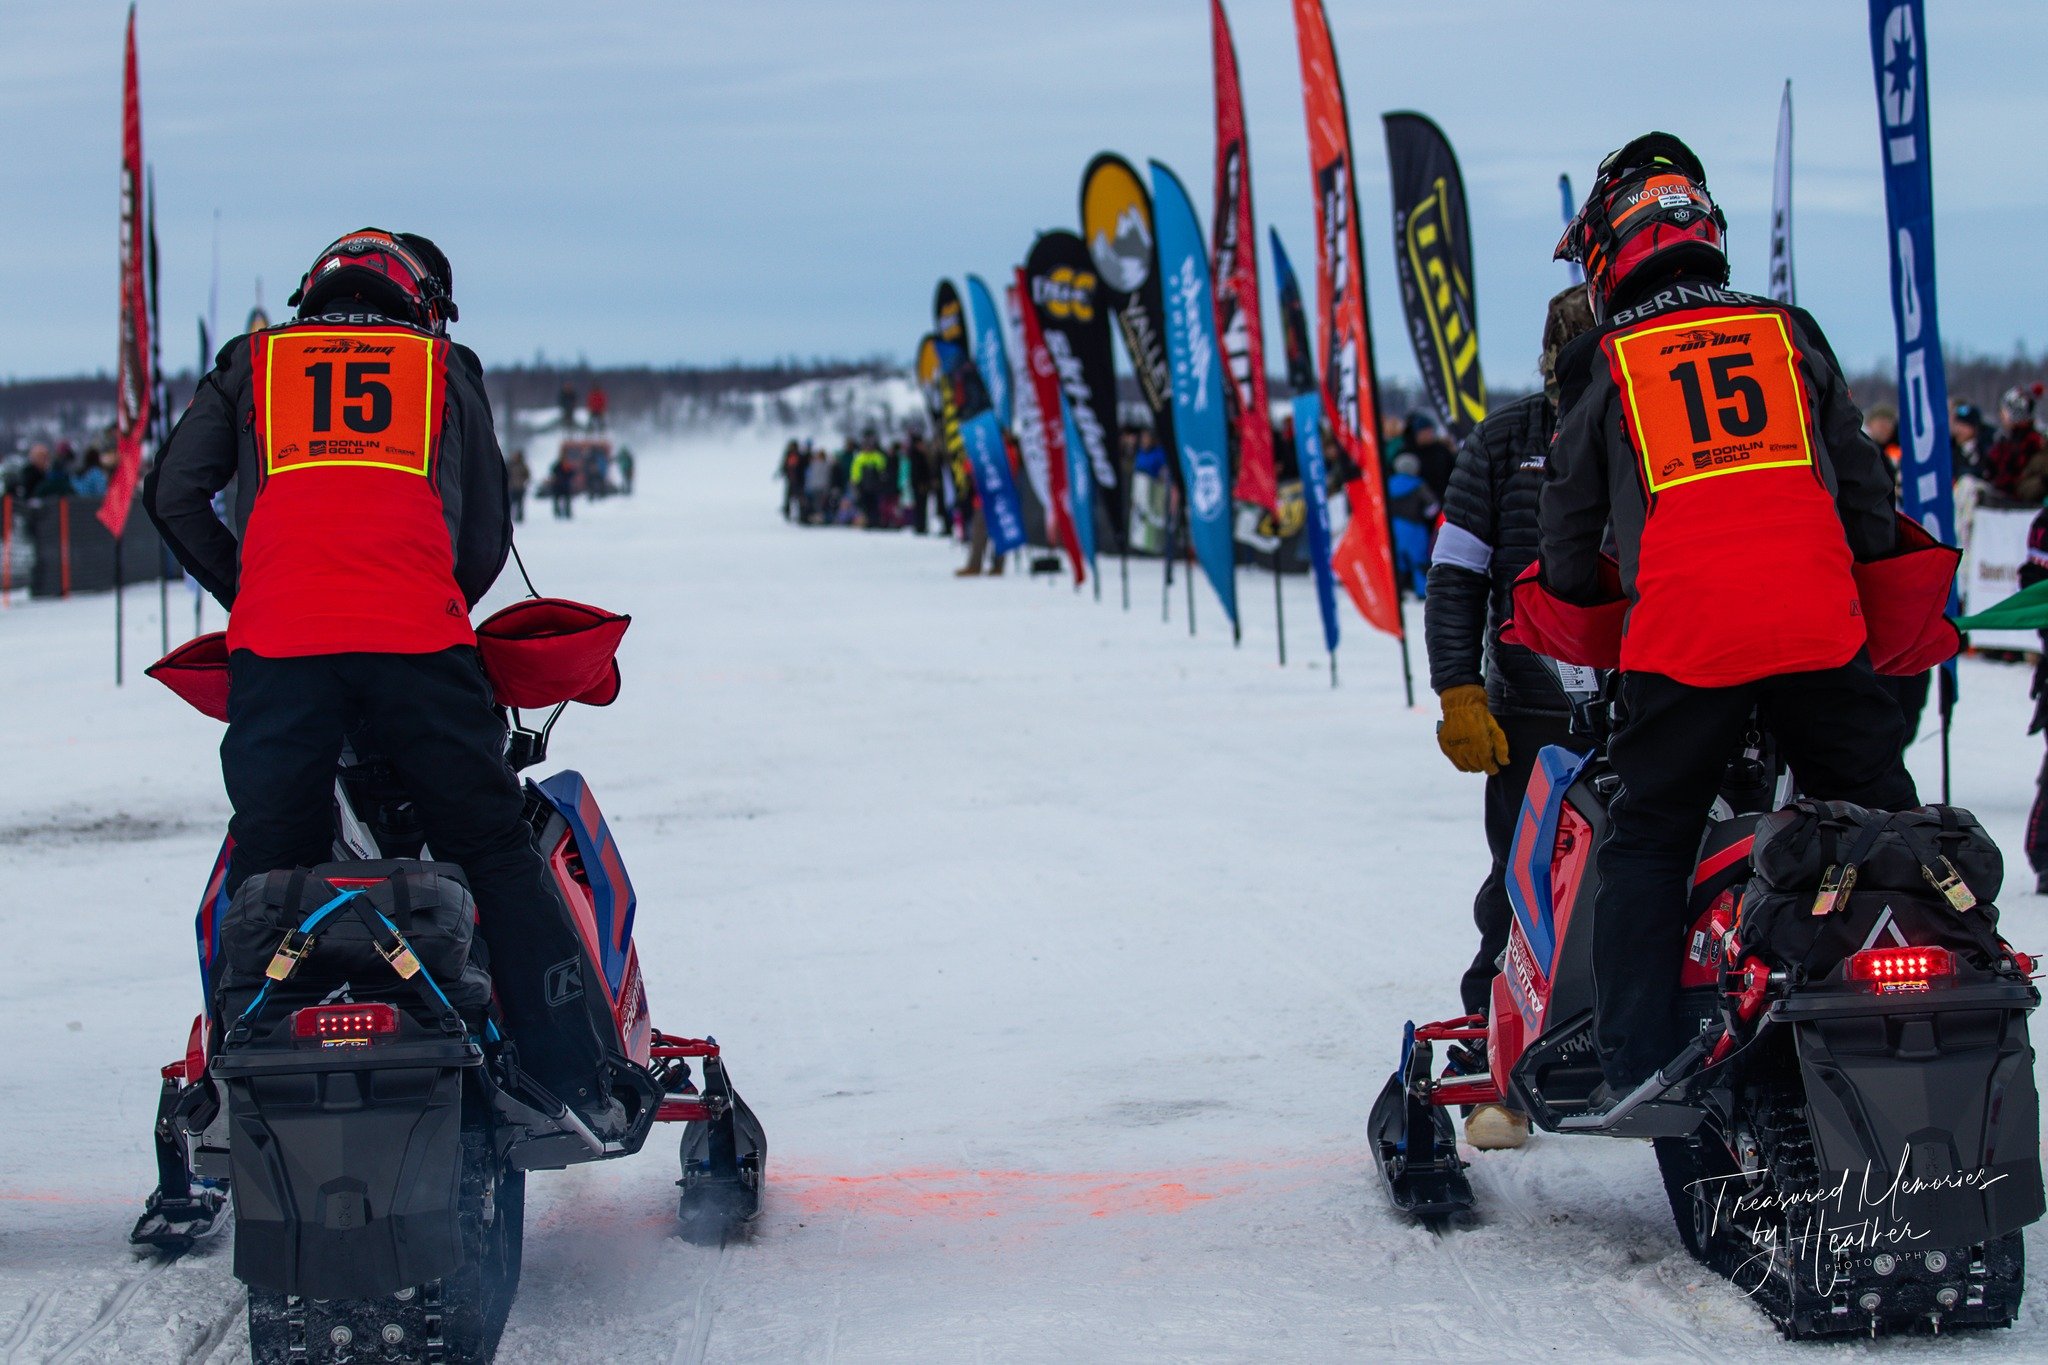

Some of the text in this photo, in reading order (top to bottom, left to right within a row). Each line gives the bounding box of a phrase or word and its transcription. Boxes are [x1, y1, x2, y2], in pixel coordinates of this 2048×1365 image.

[1674, 211, 1690, 219] DOT
[1613, 284, 1762, 326] BERNIER
[305, 362, 392, 434] 15
[1669, 352, 1768, 444] 15
[328, 440, 380, 448] DONLIN
[328, 447, 365, 455] GOLD
[1712, 441, 1764, 456] DONLIN
[1713, 452, 1750, 464] GOLD
[1510, 940, 1544, 1013] COUNTRY
